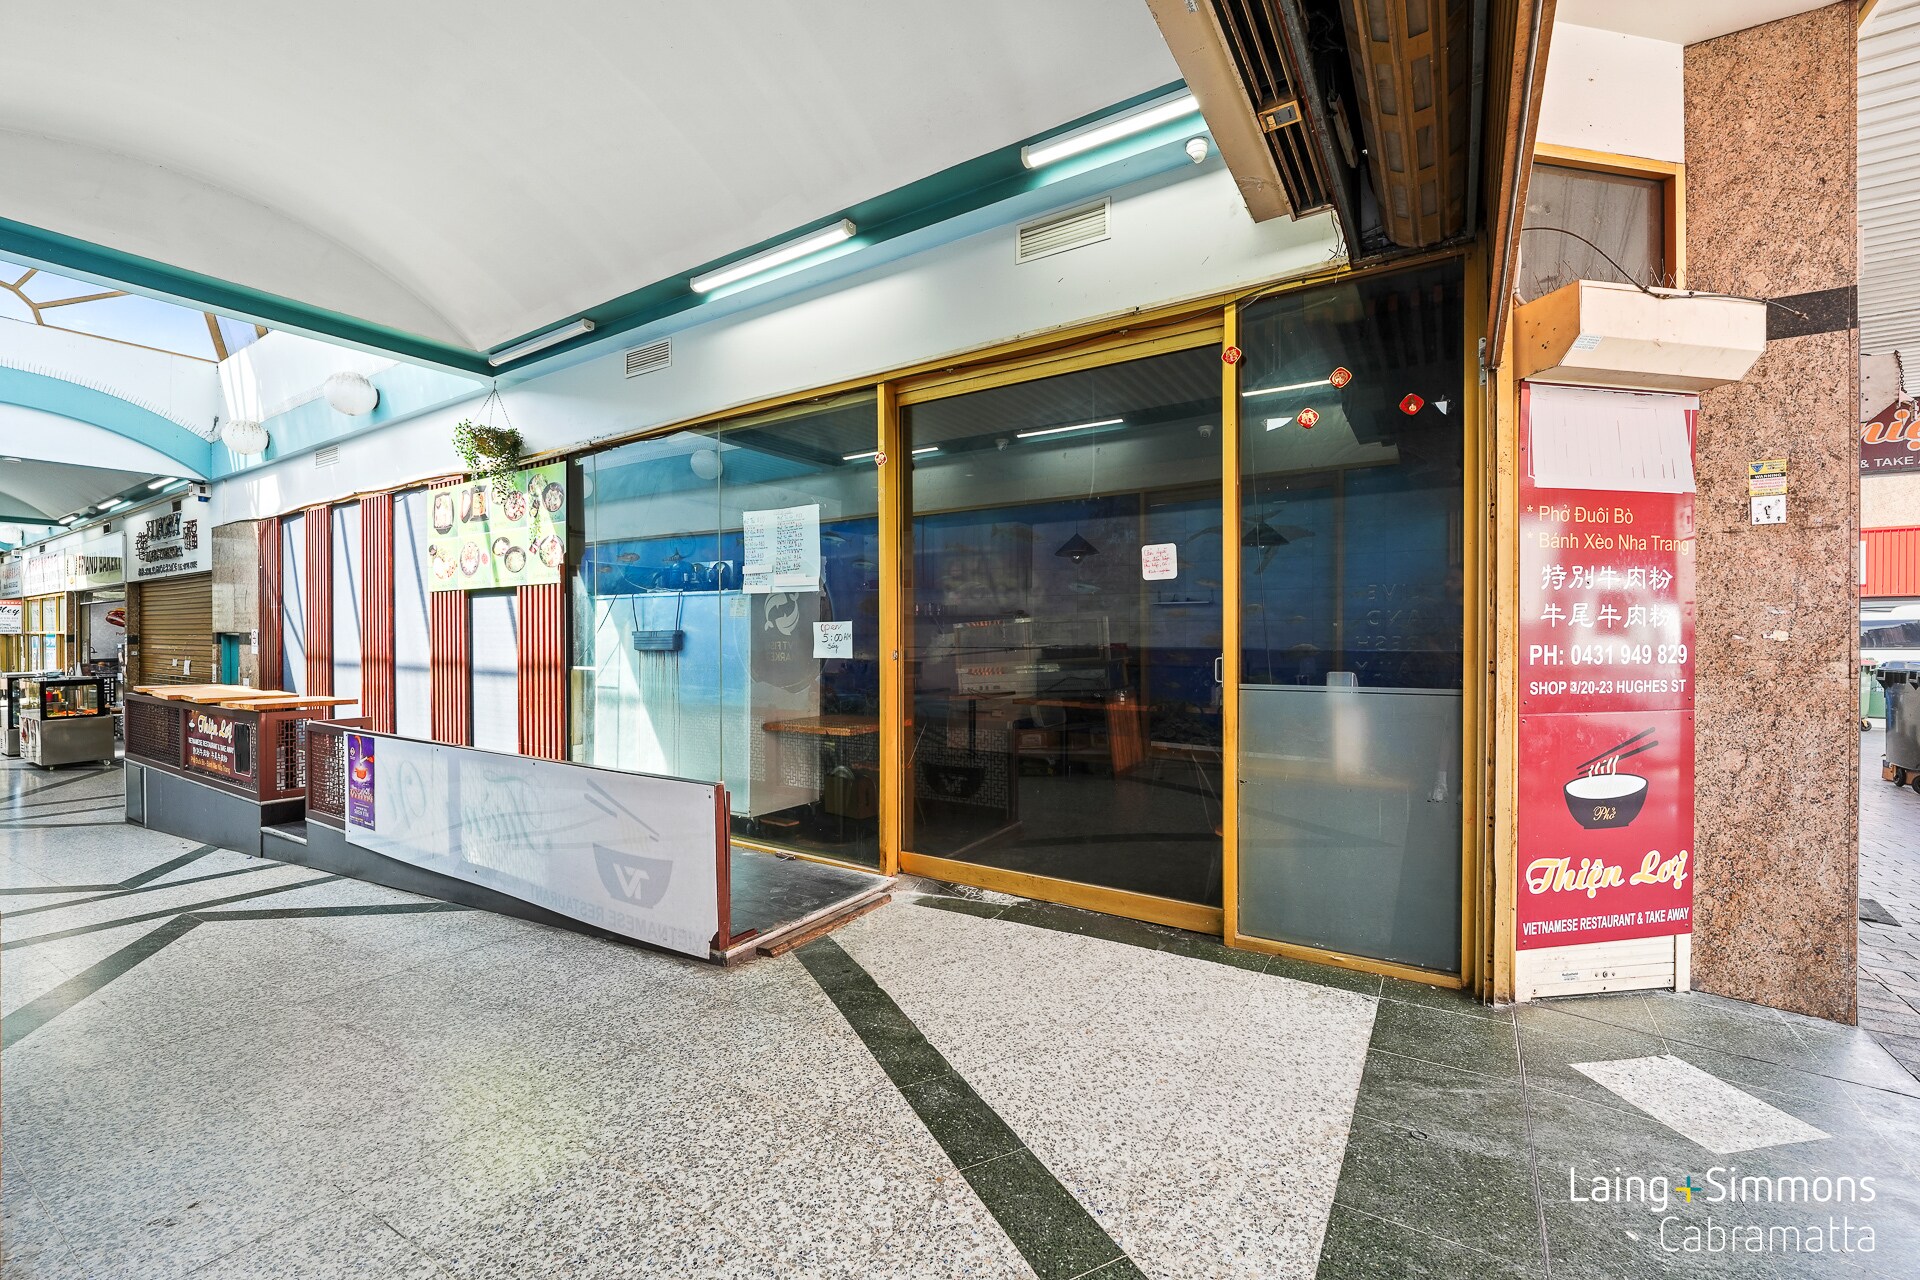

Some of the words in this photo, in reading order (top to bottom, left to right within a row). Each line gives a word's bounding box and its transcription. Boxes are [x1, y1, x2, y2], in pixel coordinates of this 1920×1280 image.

[1874, 456, 1914, 467] TAKE
[1539, 504, 1570, 522] Phở
[1574, 506, 1609, 523] Đuôi
[1614, 507, 1633, 524] Bò
[1539, 532, 1579, 549] Bánh
[1584, 533, 1614, 550] Xèo
[1618, 534, 1647, 550] Nha
[1651, 535, 1689, 555] Trang
[1540, 564, 1673, 590] 特別牛肉粉
[1540, 602, 1672, 629] 牛尾牛肉粉
[1529, 644, 1564, 666] PH:
[1571, 644, 1613, 665] 0431
[1620, 644, 1652, 665] 949
[1657, 644, 1688, 665] 829
[1529, 681, 1567, 695] SHOP
[1570, 681, 1613, 694] 3/20-23
[1617, 680, 1668, 693] HUGHES
[1671, 679, 1686, 692] ST
[1526, 857, 1625, 899] Thiện
[1523, 919, 1578, 936] VIETNAMESE
[1580, 912, 1636, 930] RESTAURANT
[1637, 912, 1643, 924] &
[1645, 910, 1666, 923] TAKE
[1667, 907, 1689, 921] AWAY
